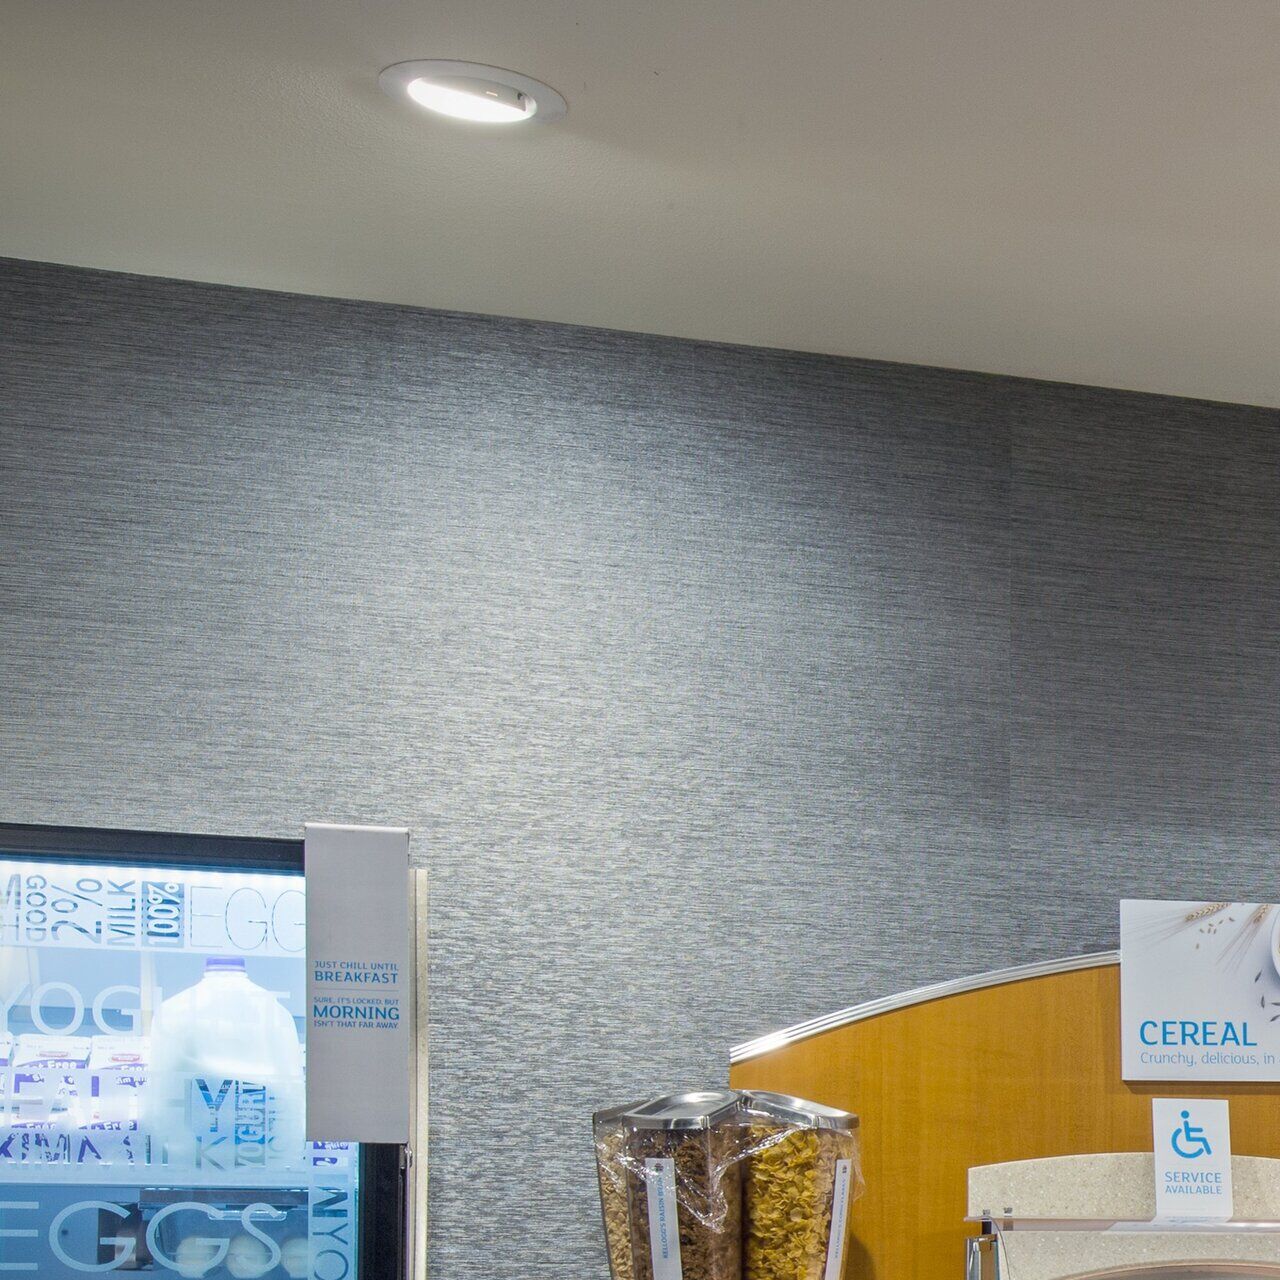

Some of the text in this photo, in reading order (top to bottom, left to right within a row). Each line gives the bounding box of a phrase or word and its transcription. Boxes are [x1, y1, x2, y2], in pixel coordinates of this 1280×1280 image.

[106, 879, 136, 947] MILK
[146, 881, 182, 945] 100%
[190, 885, 306, 953] EGG
[314, 960, 399, 971] JUST CHILL UNTIL
[313, 970, 399, 984] BREAKFAST
[384, 998, 399, 1006] BUT
[313, 1004, 400, 1021] MORNING
[313, 1020, 334, 1028] ISN'T
[337, 1020, 357, 1028] THAT
[358, 1021, 374, 1029] FAR
[1139, 1020, 1258, 1047] CEREAL
[1140, 1051, 1197, 1067] Crunchy,
[1201, 1051, 1260, 1066] delicious,
[1264, 1052, 1276, 1065] in
[1164, 1171, 1223, 1184] SERVICE
[1165, 1185, 1223, 1195] AVAILABLE
